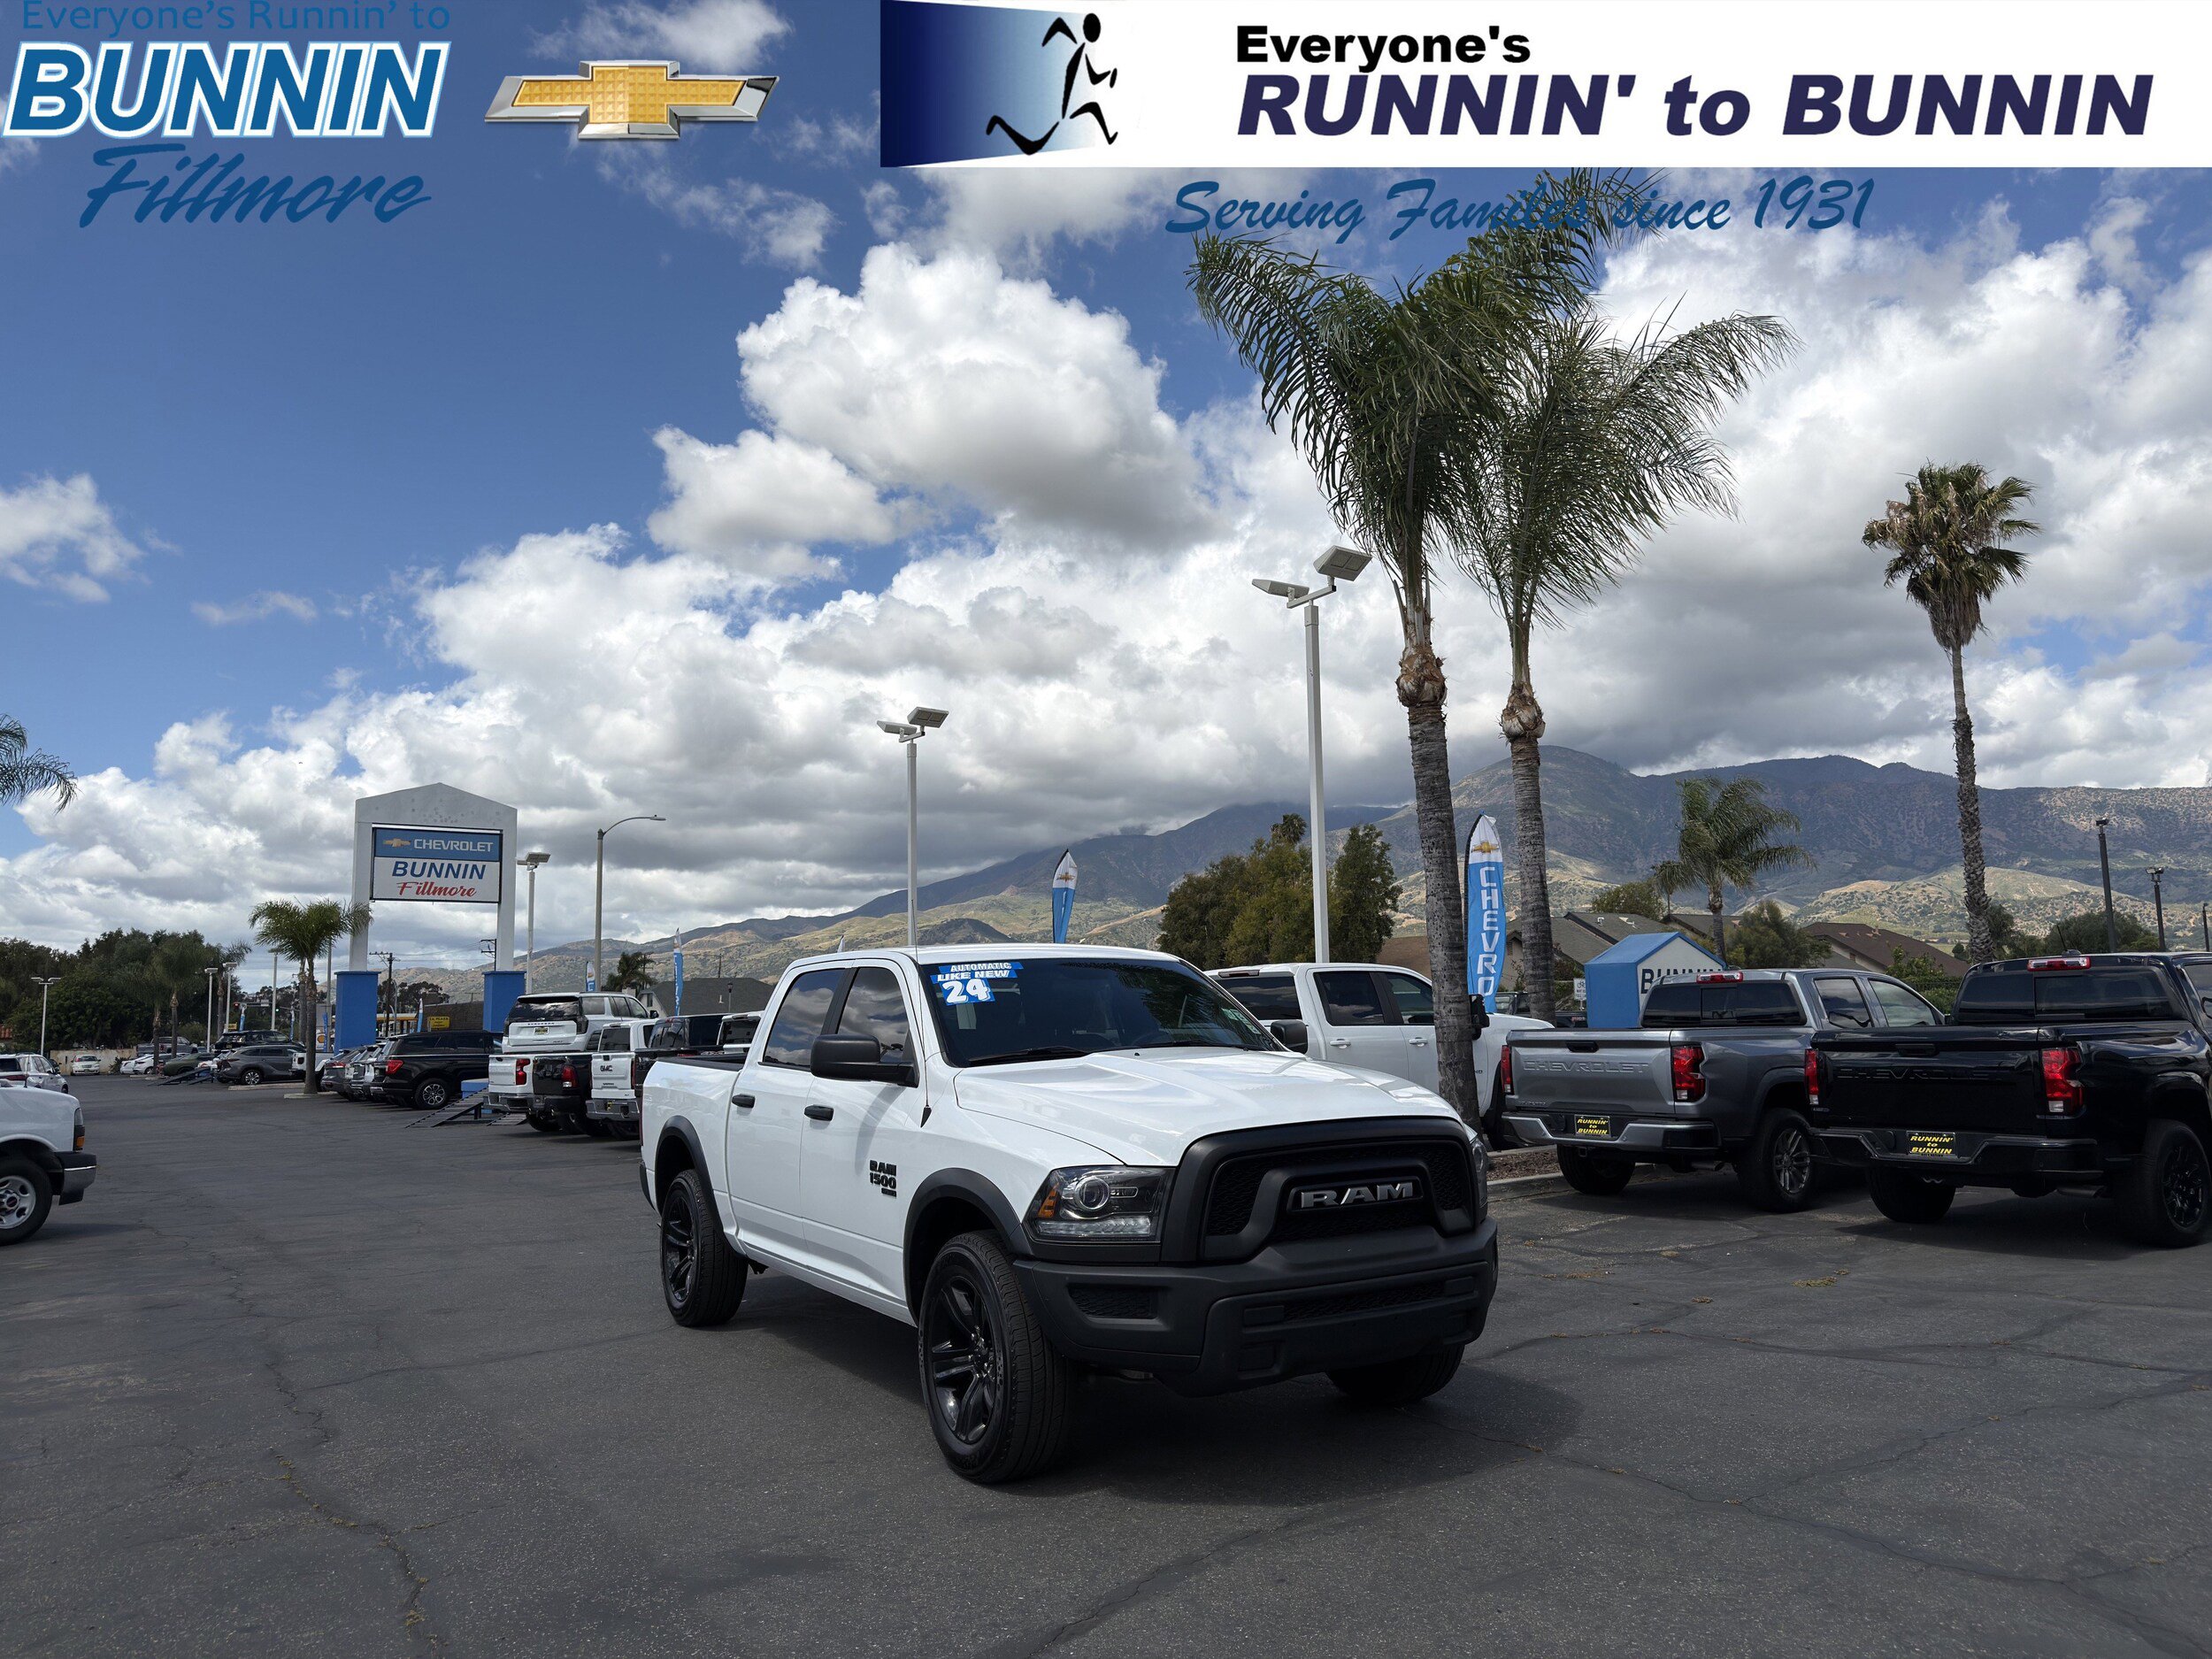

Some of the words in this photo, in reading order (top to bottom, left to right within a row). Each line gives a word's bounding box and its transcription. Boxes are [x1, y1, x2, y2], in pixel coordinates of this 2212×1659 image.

[413, 839, 494, 852] CHEVROLET
[392, 861, 487, 879] BUNNIN
[396, 881, 477, 896] Fillmore
[950, 962, 1012, 972] AUTOMATIC
[937, 972, 972, 982] LIKE
[974, 970, 1010, 979] NEW
[942, 979, 991, 1003] 24
[1524, 1061, 1649, 1073] CHEVROLET
[869, 1160, 897, 1176] RAM
[869, 1172, 897, 1189] 1500
[1302, 1182, 1413, 1209] RAM
